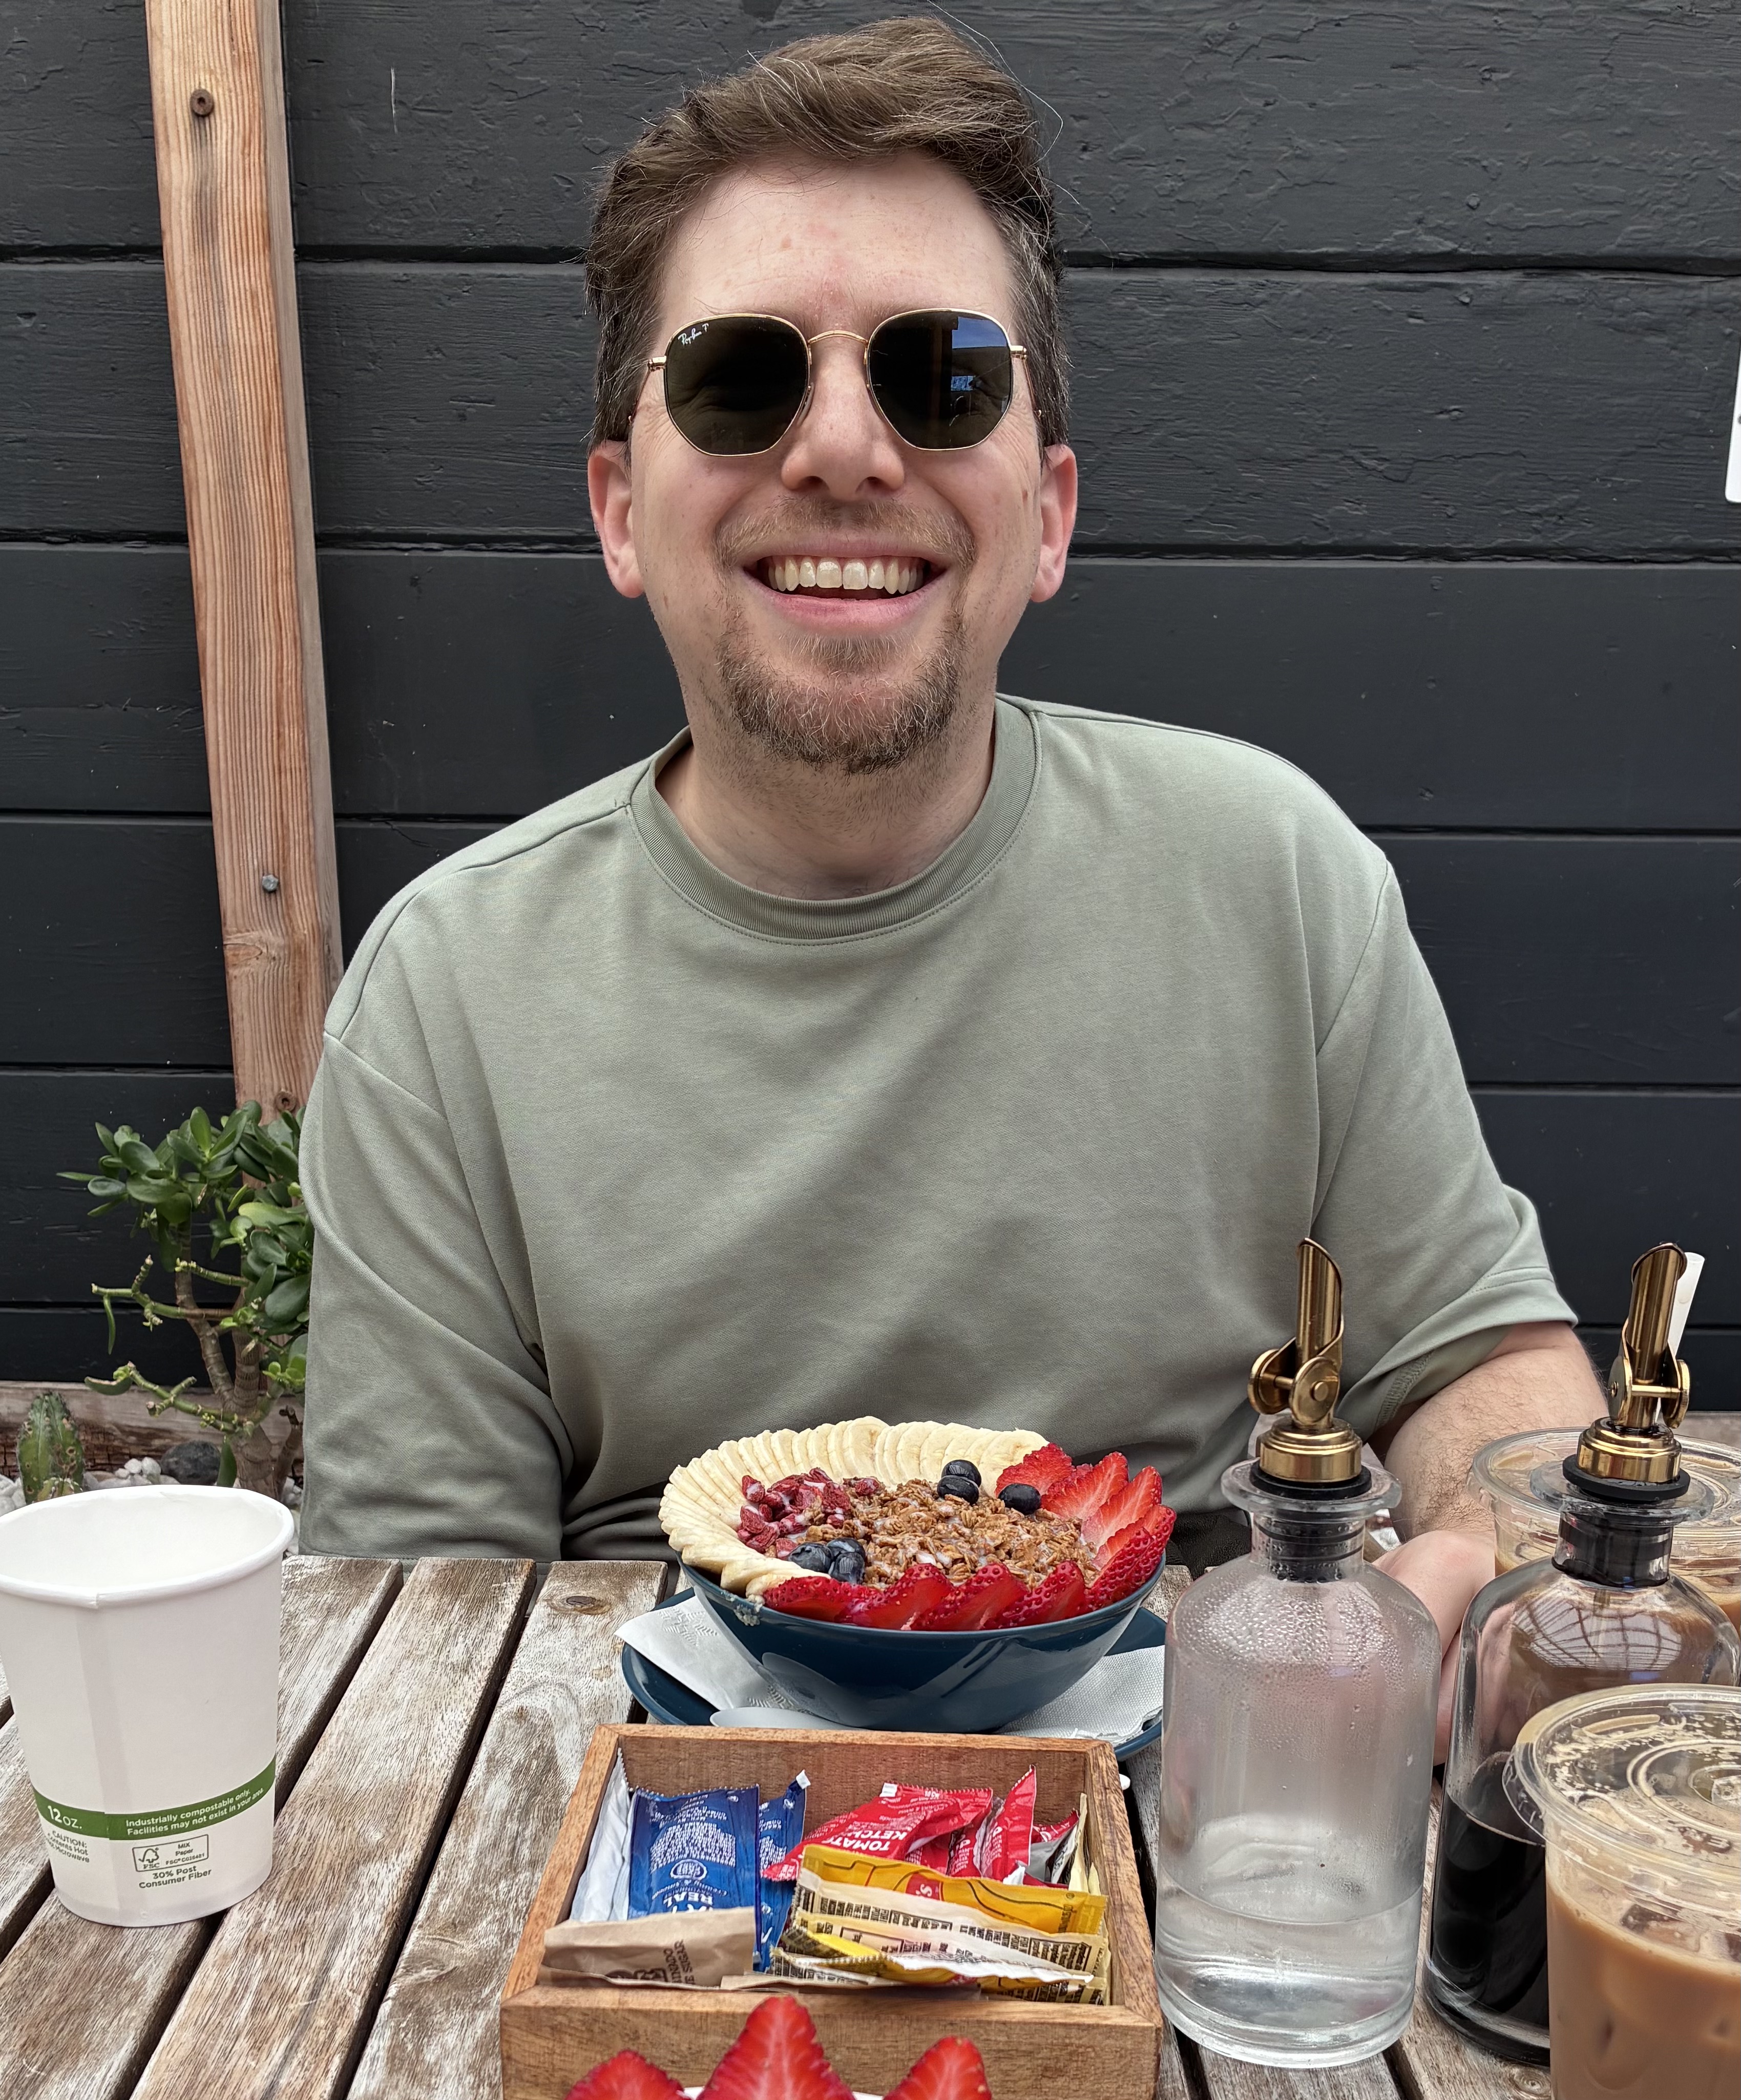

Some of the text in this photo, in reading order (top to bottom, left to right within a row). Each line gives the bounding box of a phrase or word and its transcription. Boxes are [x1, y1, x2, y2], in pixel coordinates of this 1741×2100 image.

[126, 1789, 251, 1827] Industrially compostable only.
[128, 1823, 169, 1835] Facilities
[171, 1820, 190, 1831] may
[192, 1816, 207, 1825] not
[209, 1807, 227, 1820] exist
[229, 1804, 236, 1813] in
[237, 1797, 253, 1810] your
[52, 1831, 87, 1848] CAUTION:
[74, 1846, 89, 1856] Hot
[139, 1870, 212, 1888] Consumer Fiber
[153, 1866, 197, 1879] 30% Post
[663, 1892, 713, 1907] REAL
[674, 1939, 693, 1973] SUGAR
